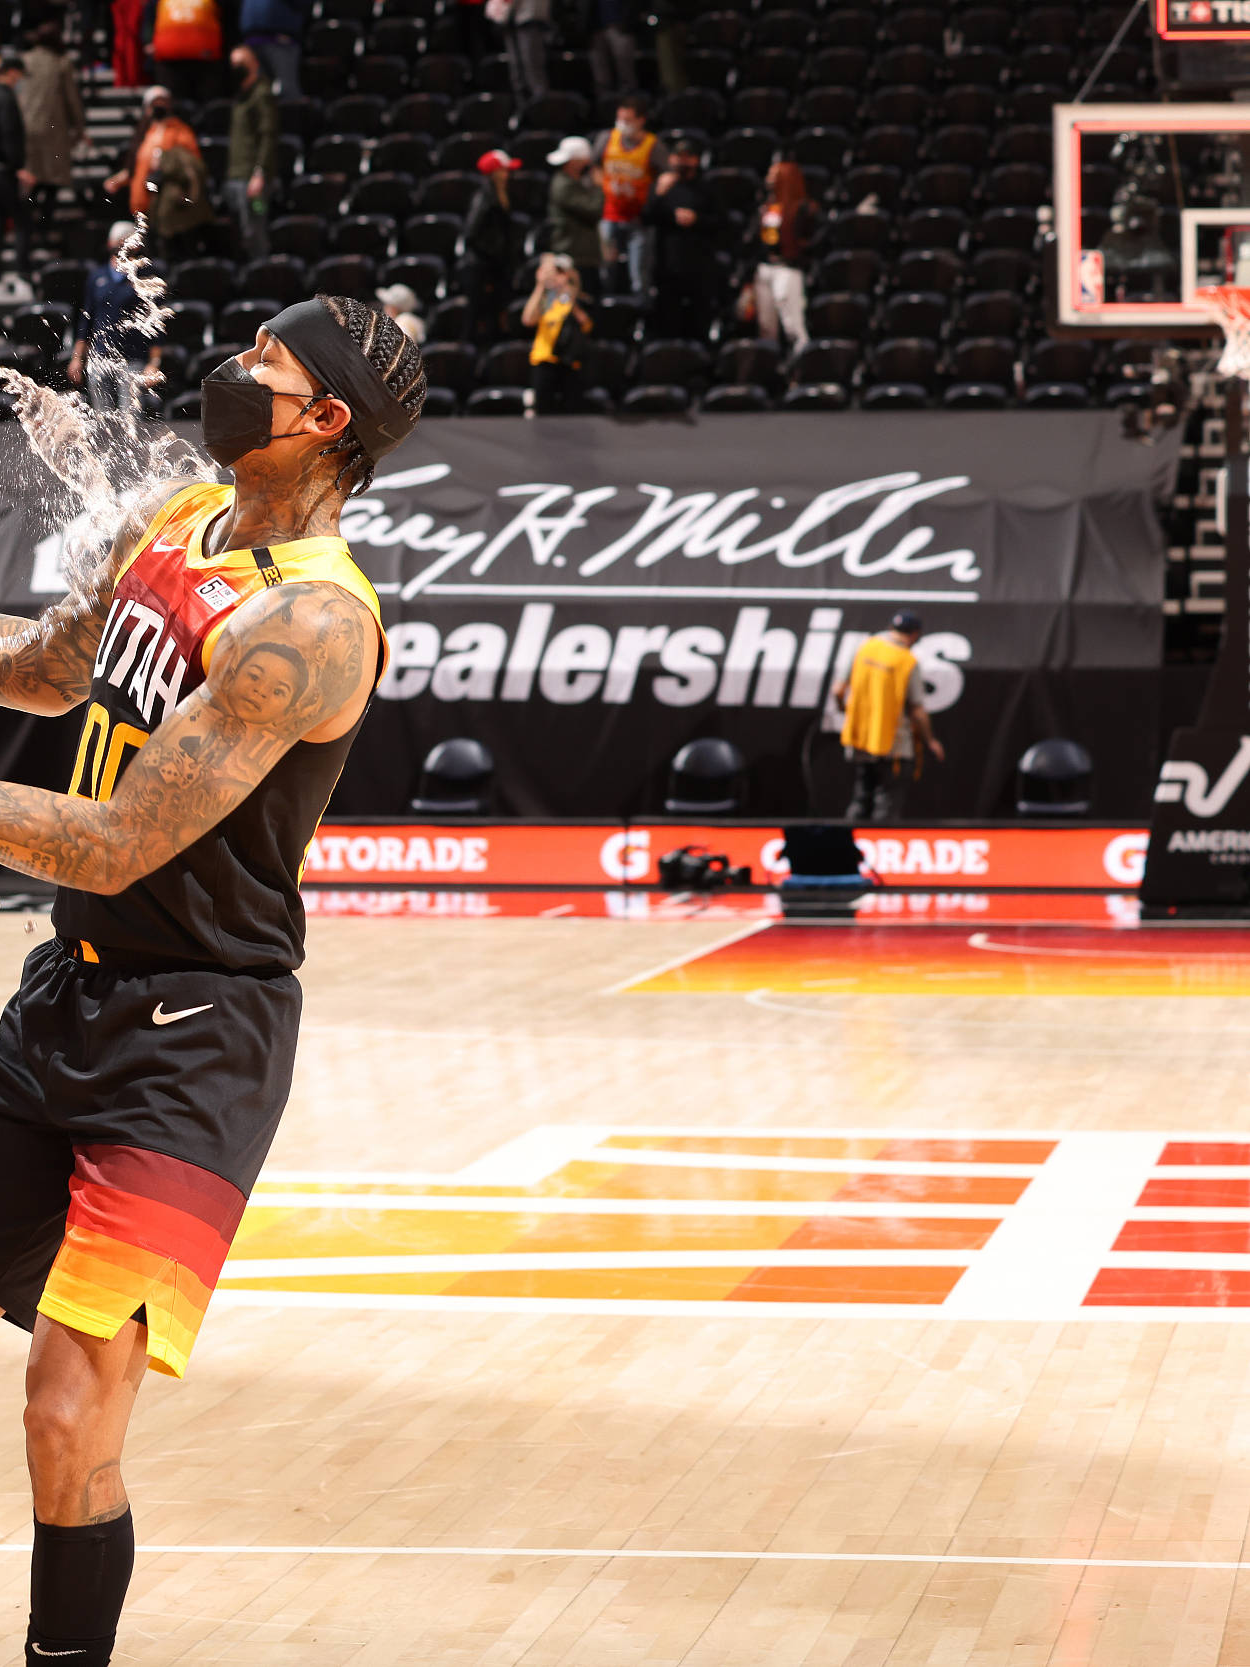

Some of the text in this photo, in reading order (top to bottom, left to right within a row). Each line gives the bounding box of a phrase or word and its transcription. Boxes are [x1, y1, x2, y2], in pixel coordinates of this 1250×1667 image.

[579, 471, 982, 582] Miller
[92, 598, 188, 725] UTAH
[374, 603, 972, 714] ealershis
[302, 836, 489, 872] ATORADE
